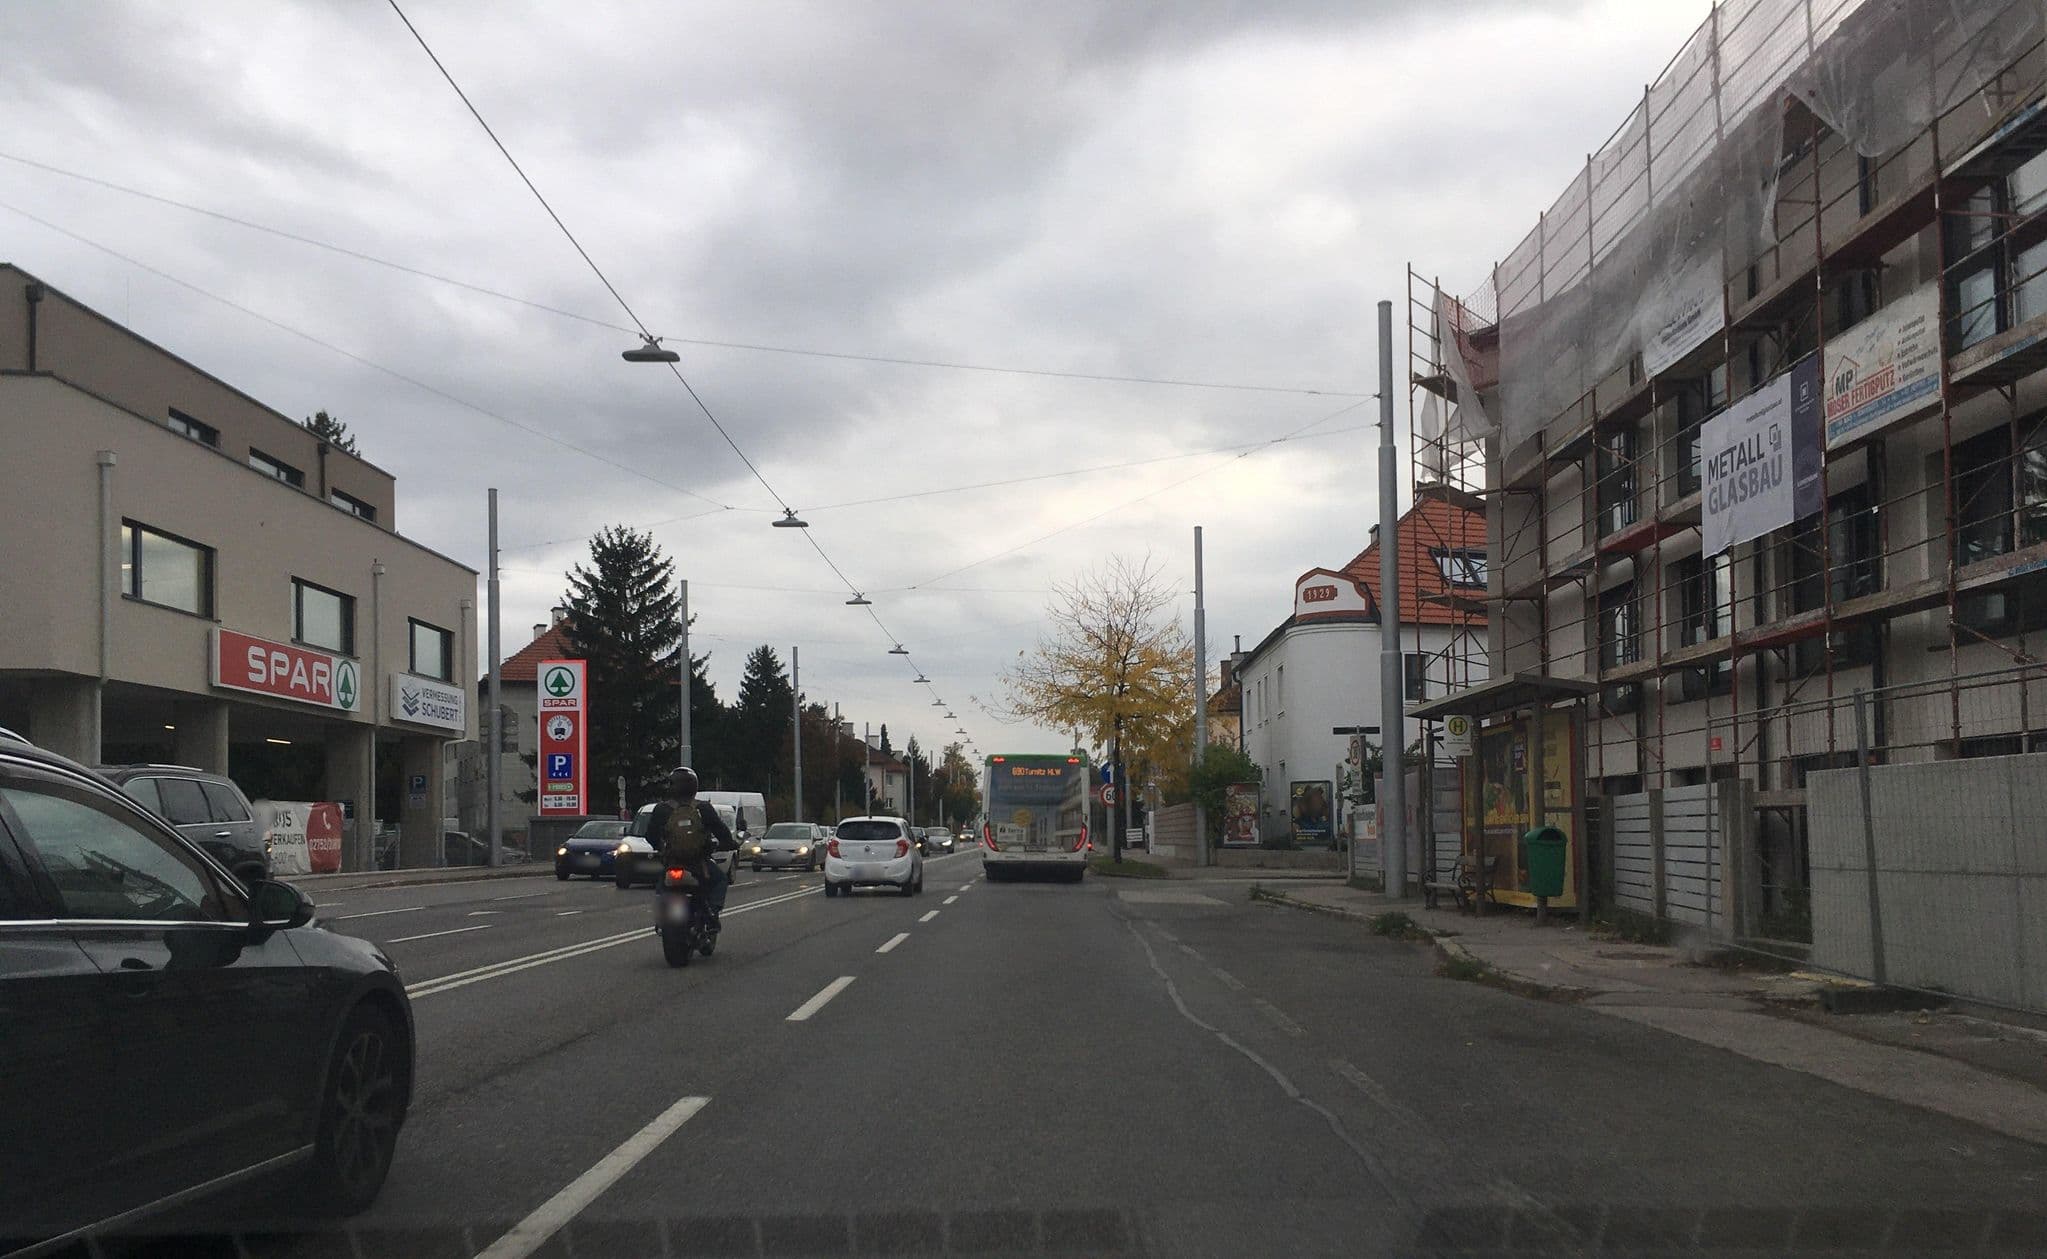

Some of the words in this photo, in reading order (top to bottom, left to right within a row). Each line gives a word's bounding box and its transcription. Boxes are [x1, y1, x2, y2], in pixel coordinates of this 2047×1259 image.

[1835, 369, 1854, 396] MP
[1851, 369, 1896, 407] FERTIGPUTZ
[1707, 432, 1765, 485] METALL
[1707, 453, 1783, 516] GLASBAU
[1307, 588, 1330, 600] 1929
[247, 645, 331, 697] SPAR
[422, 702, 458, 722] SCHUBERT
[544, 699, 577, 707] SPAR
[1454, 720, 1463, 732] H
[554, 756, 567, 771] P
[412, 776, 424, 788] P
